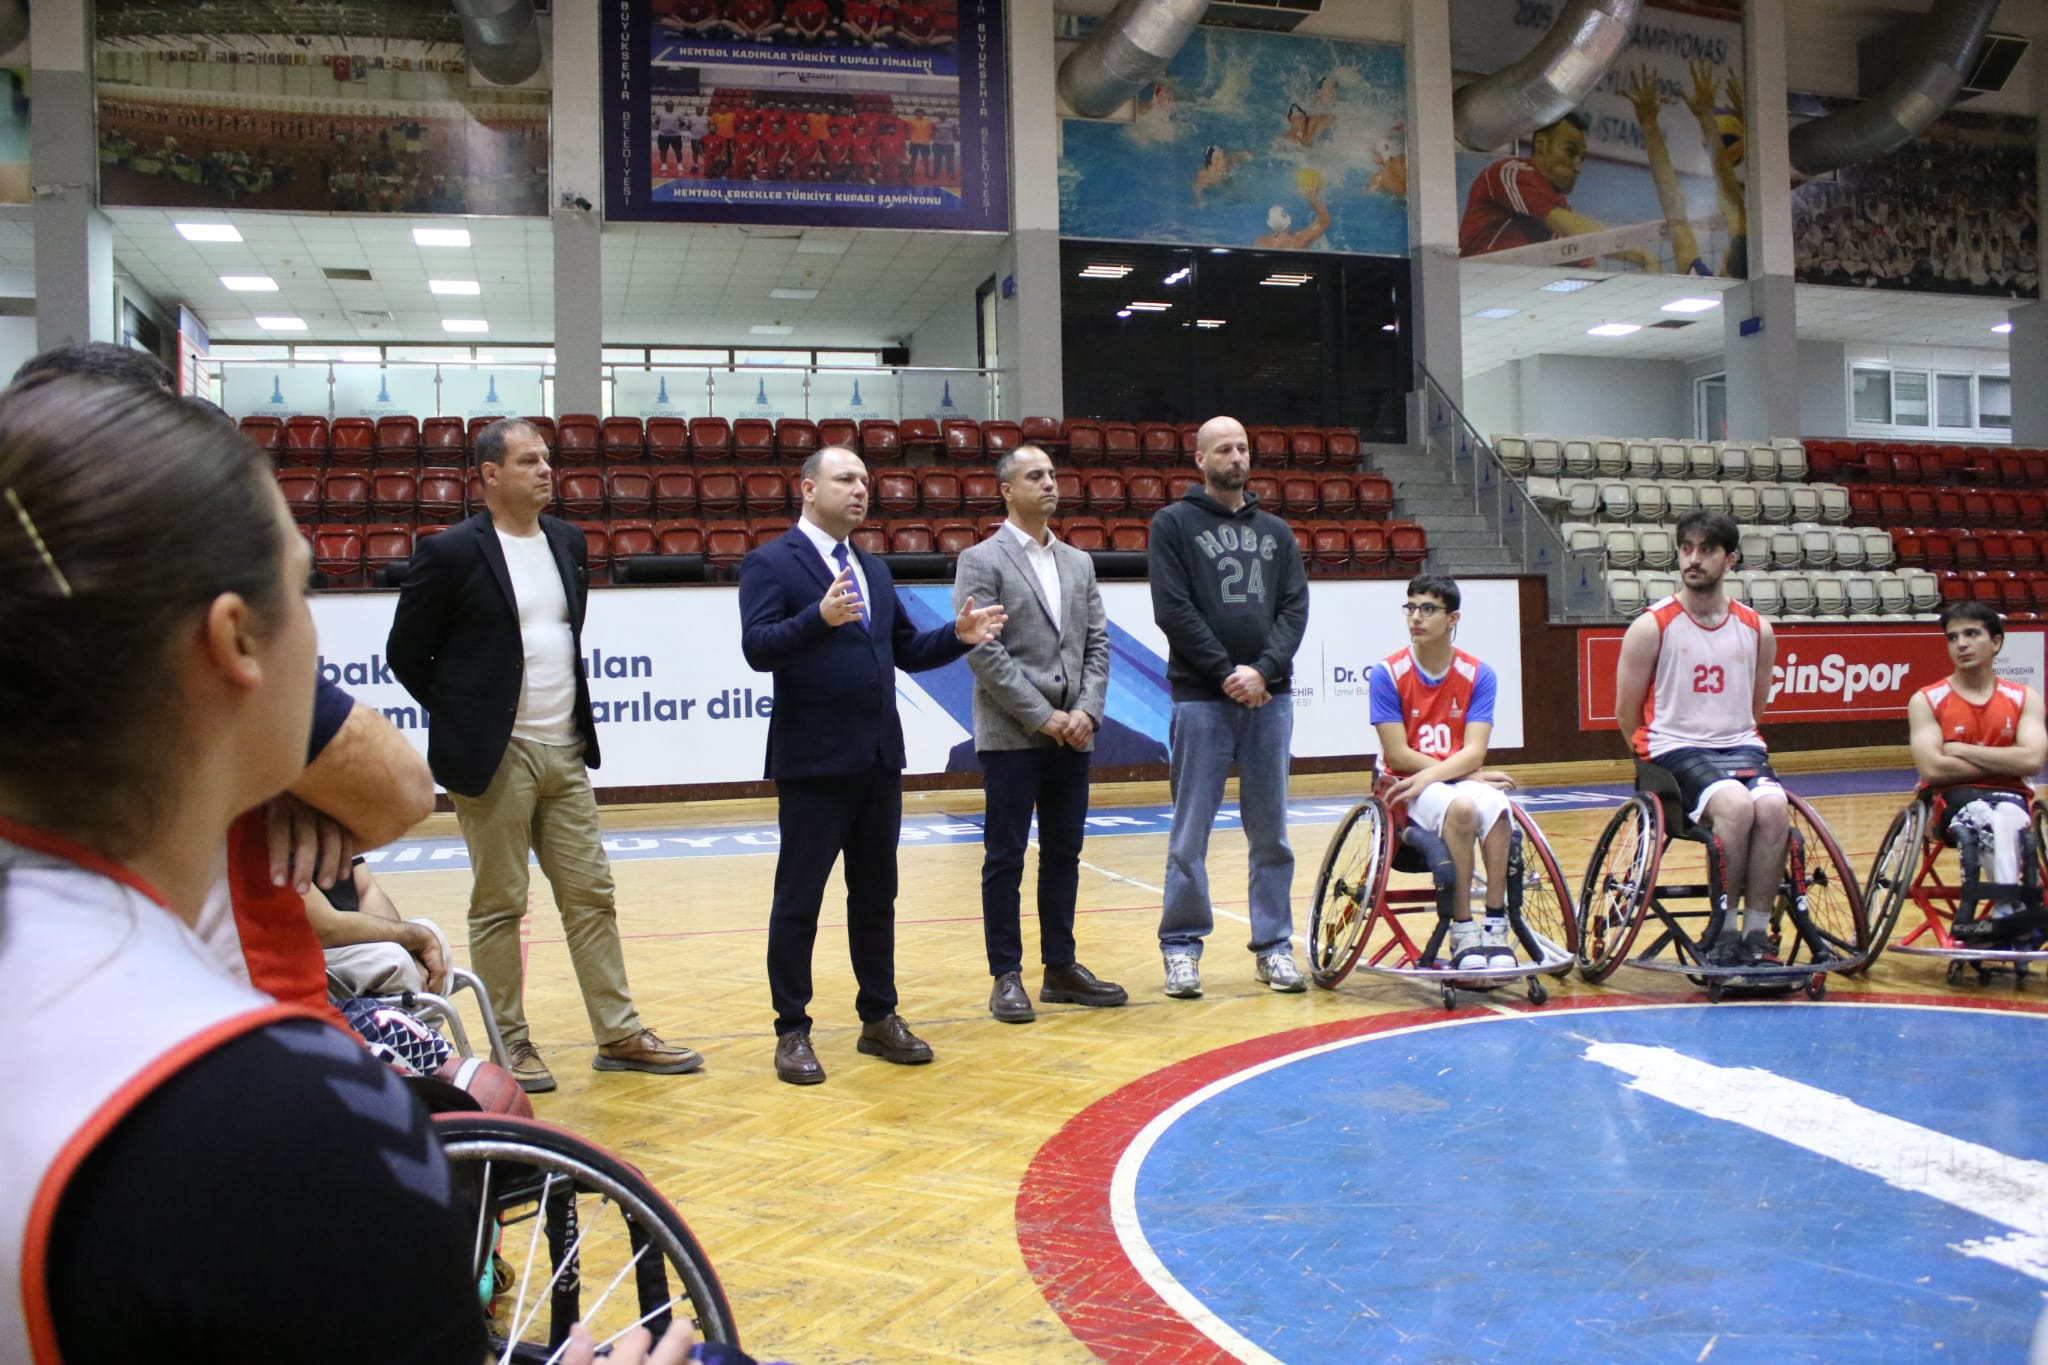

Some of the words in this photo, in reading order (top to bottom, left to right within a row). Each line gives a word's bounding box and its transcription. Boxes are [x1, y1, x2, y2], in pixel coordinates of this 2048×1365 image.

[679, 46, 728, 58] HENTBOL
[732, 49, 787, 61] KADINLAR
[791, 50, 836, 63] TÜRKİYE
[840, 55, 879, 66] KUPASI
[882, 55, 932, 69] FİNALİSTİ
[673, 187, 723, 198] HENTBOL
[727, 189, 783, 200] ERKEKLER
[786, 188, 832, 202] TÜRKİYE
[835, 191, 875, 203] KUPASI
[878, 193, 942, 206] ŞAMPİYONU
[1217, 557, 1266, 603] 24
[1334, 666, 1357, 683] Dr.
[1693, 664, 1724, 694] 23
[591, 690, 697, 724] arılar
[706, 687, 774, 719] dile
[1418, 723, 1451, 754] 20
